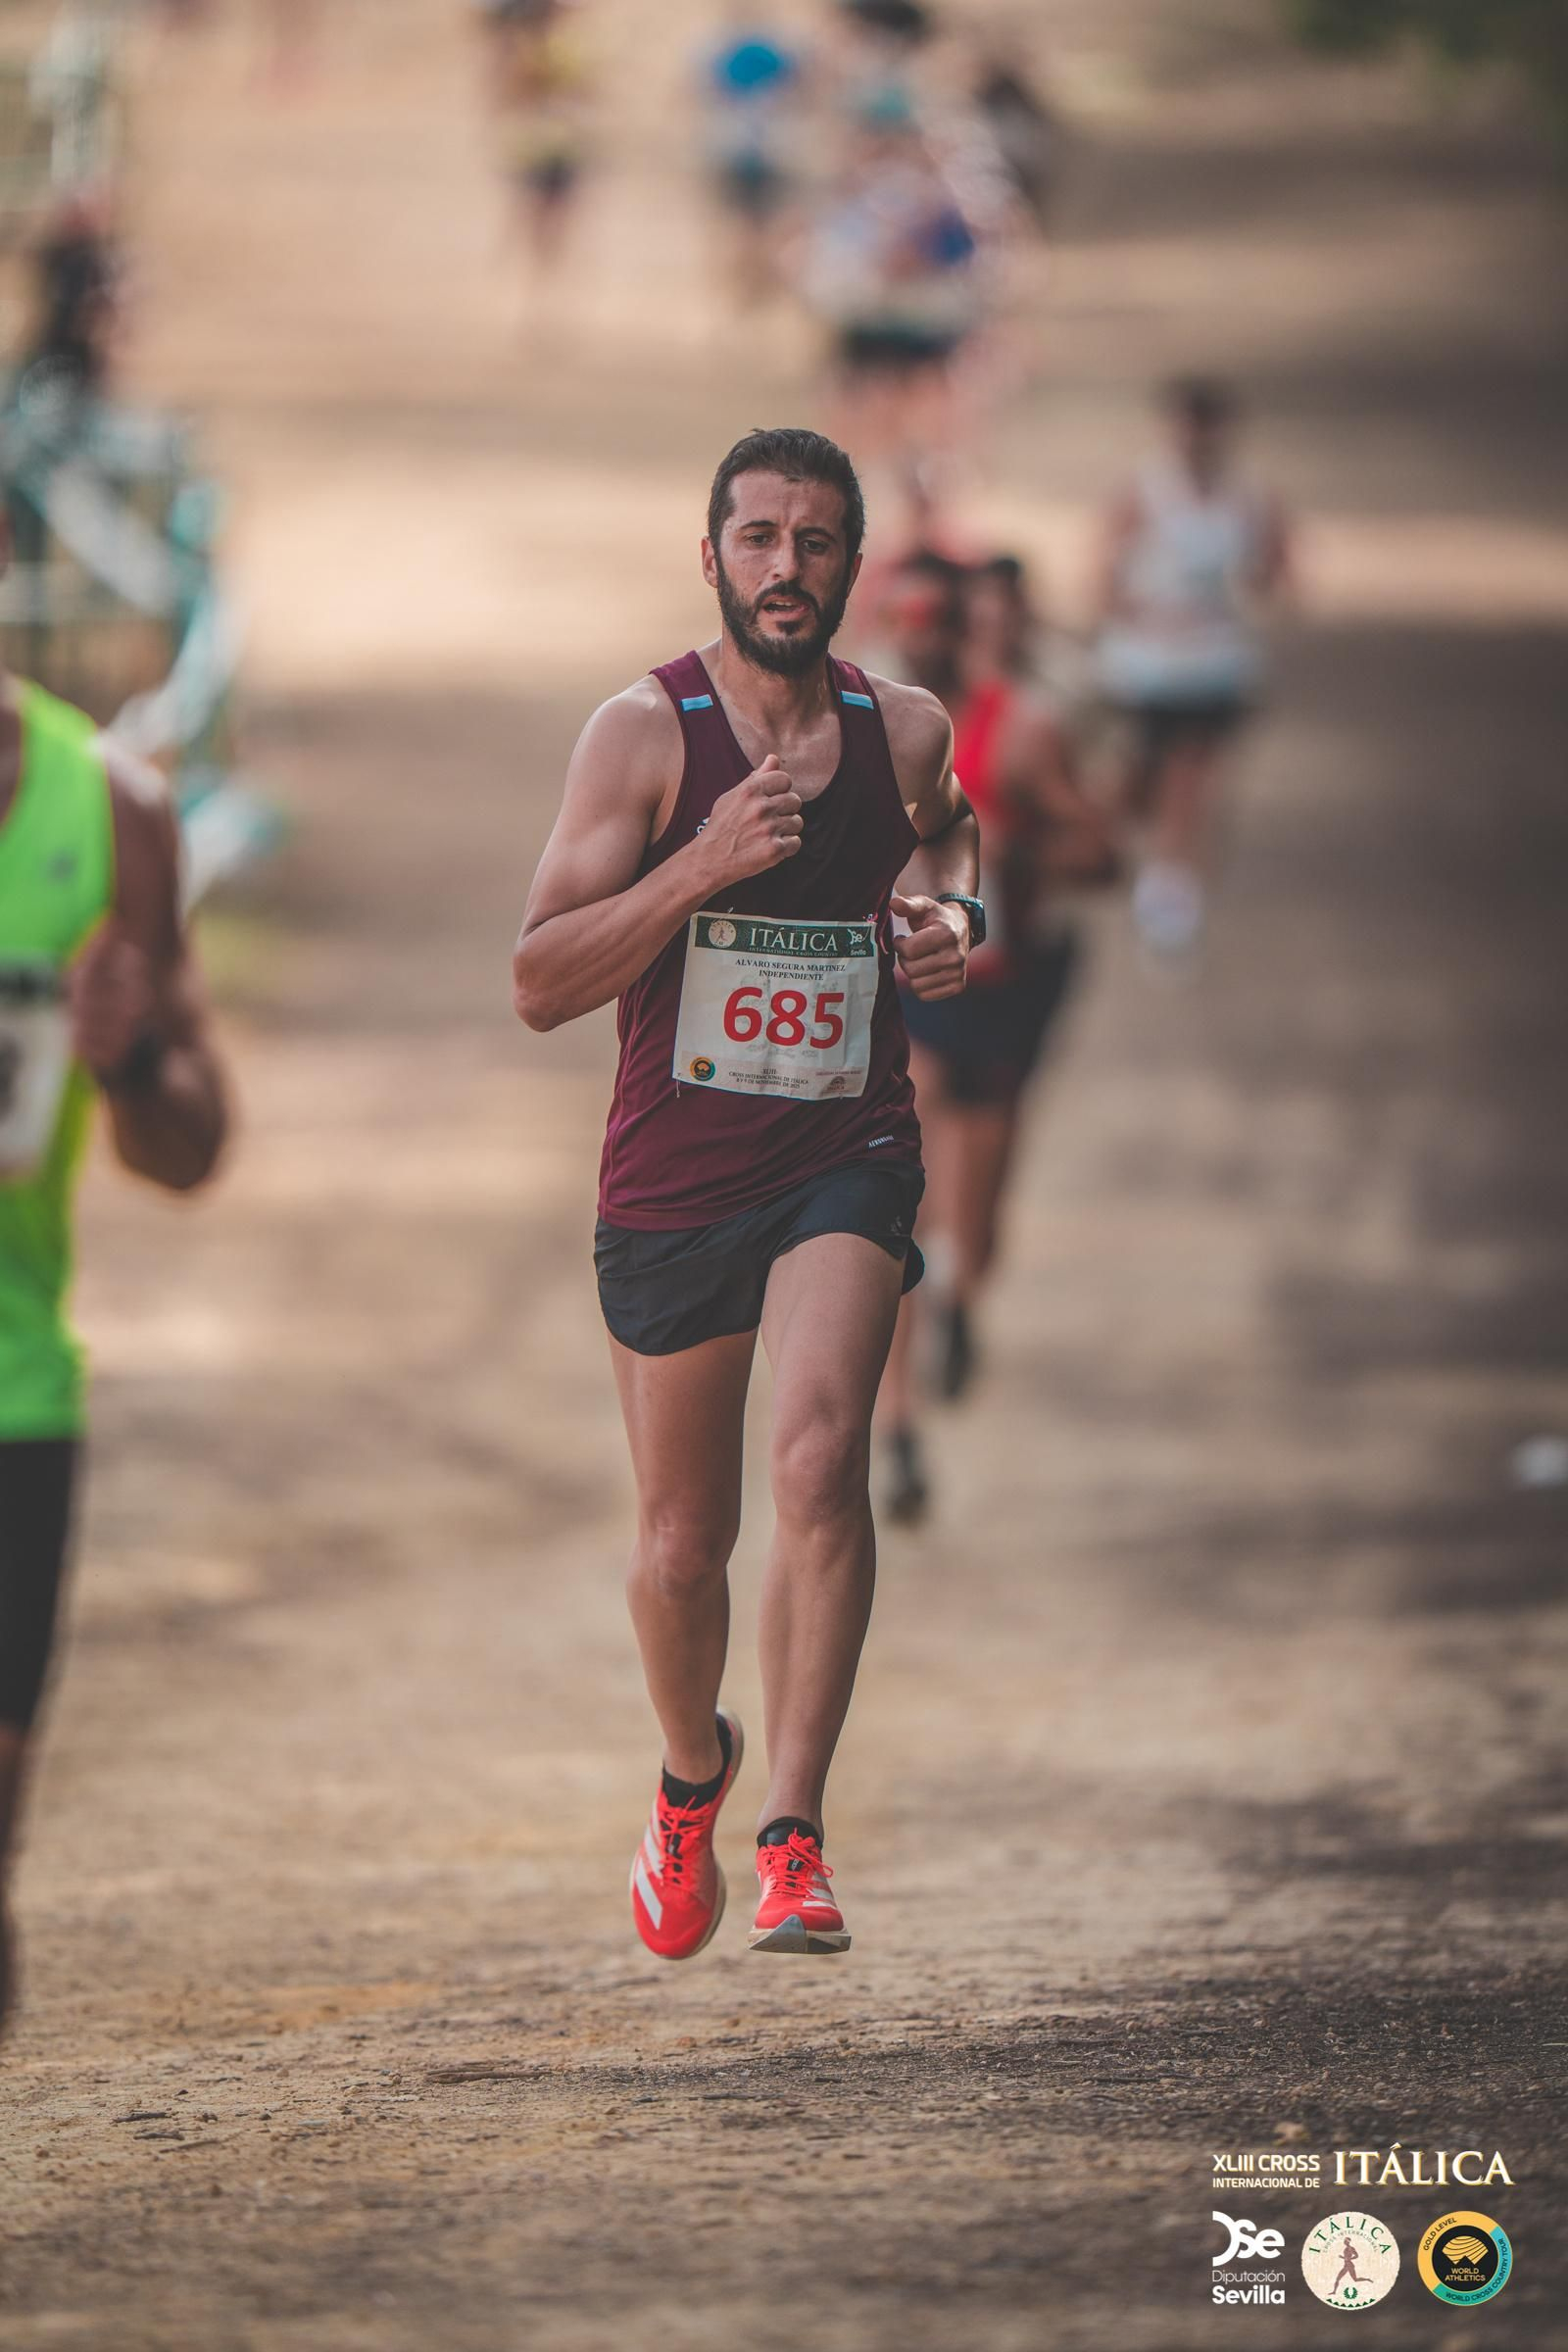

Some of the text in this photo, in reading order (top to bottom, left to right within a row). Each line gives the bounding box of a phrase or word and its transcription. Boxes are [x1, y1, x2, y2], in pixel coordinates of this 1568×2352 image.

[749, 927, 838, 952] ITÁLICA
[735, 958, 770, 967] ALVARO
[771, 962, 805, 971] SEGURA
[759, 969, 824, 981] INDEPENDIENTE
[723, 986, 845, 1050] 685
